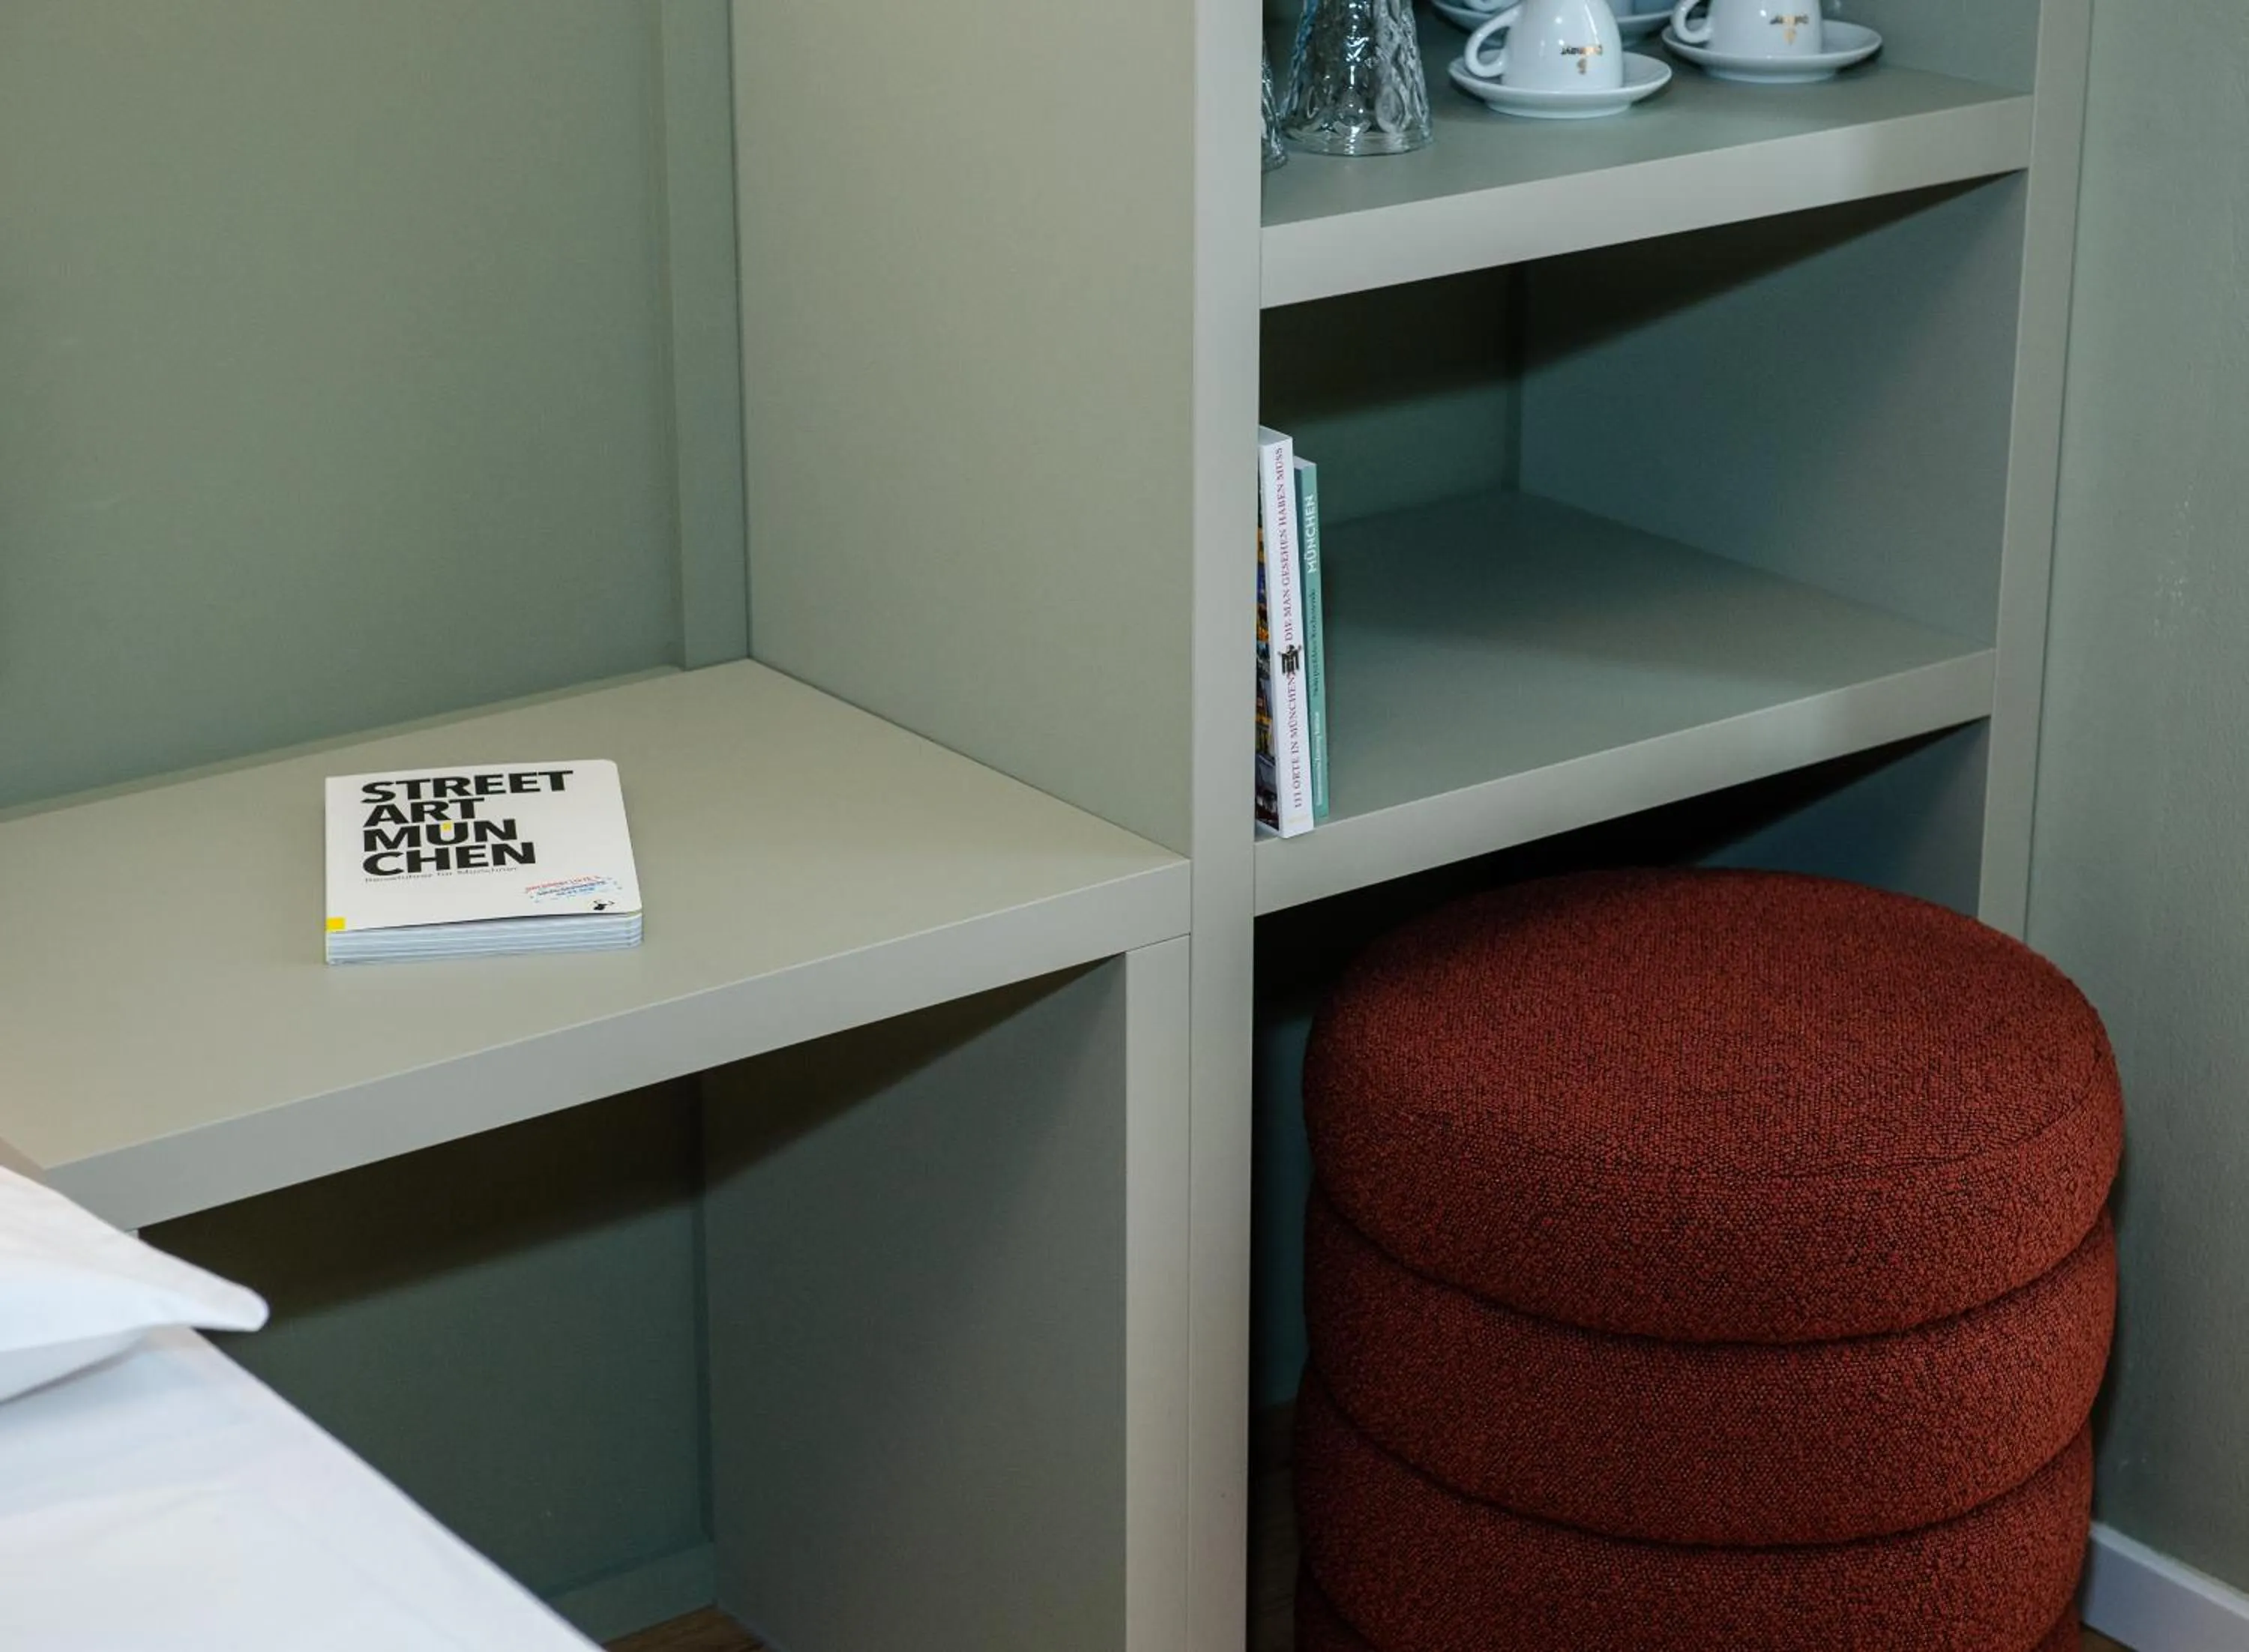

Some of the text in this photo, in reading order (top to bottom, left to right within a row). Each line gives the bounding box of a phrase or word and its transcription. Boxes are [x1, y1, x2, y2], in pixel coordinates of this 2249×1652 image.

[1274, 447, 1284, 480] MUSS
[1276, 483, 1287, 525] HABEN
[1303, 493, 1317, 575] MÜNCHEN
[1278, 528, 1291, 586] GESEHEN
[1282, 589, 1292, 617] MAN
[1283, 620, 1293, 641] DIE
[1286, 678, 1299, 739] MÜNCHEN
[1290, 741, 1299, 753] IN
[360, 770, 573, 804] STREET
[1292, 759, 1301, 791] ORTE
[363, 797, 485, 827] ART
[361, 841, 537, 876] CHEN
